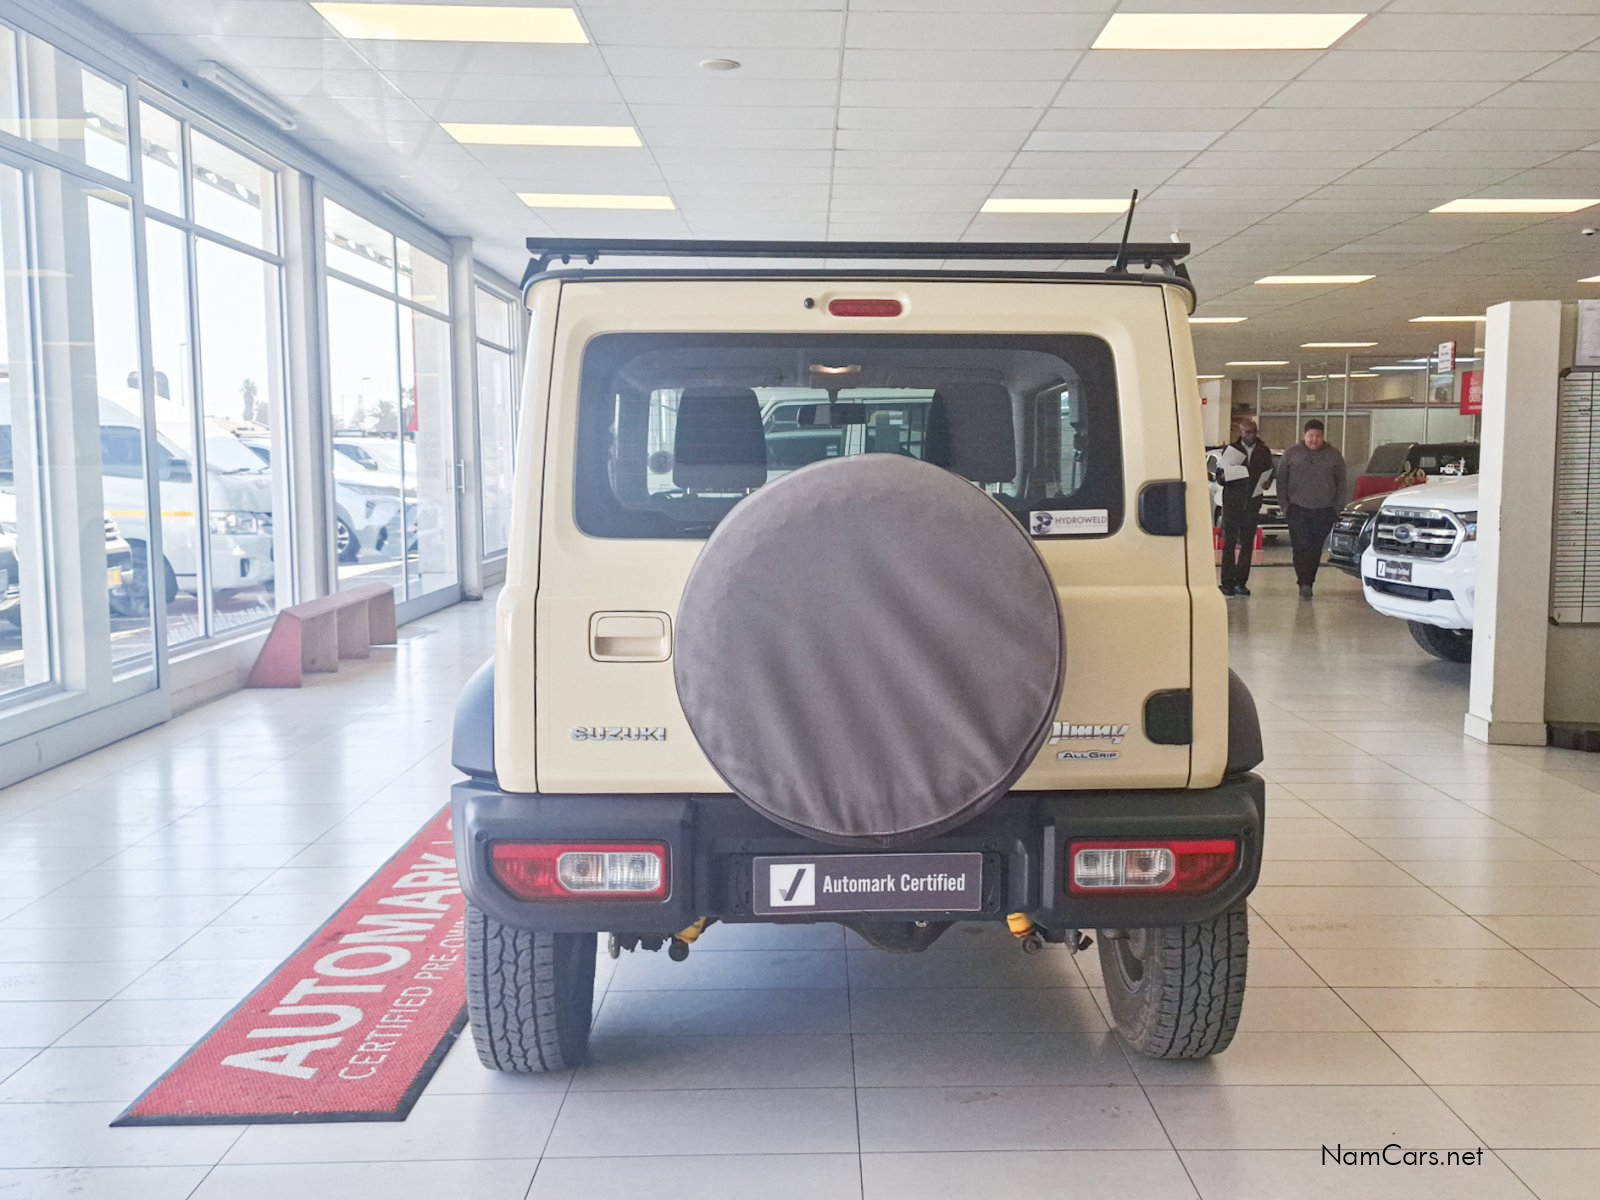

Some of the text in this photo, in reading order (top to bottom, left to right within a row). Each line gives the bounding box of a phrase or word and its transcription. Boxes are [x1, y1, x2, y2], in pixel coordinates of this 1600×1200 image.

[1055, 515, 1107, 526] HYDROWELD
[571, 726, 667, 741] SUZUKI
[1048, 721, 1130, 746] Jimny
[823, 873, 966, 893] Automark Certified
[220, 853, 462, 1080] AUTOMARK
[338, 985, 433, 1080] CERTIFIED
